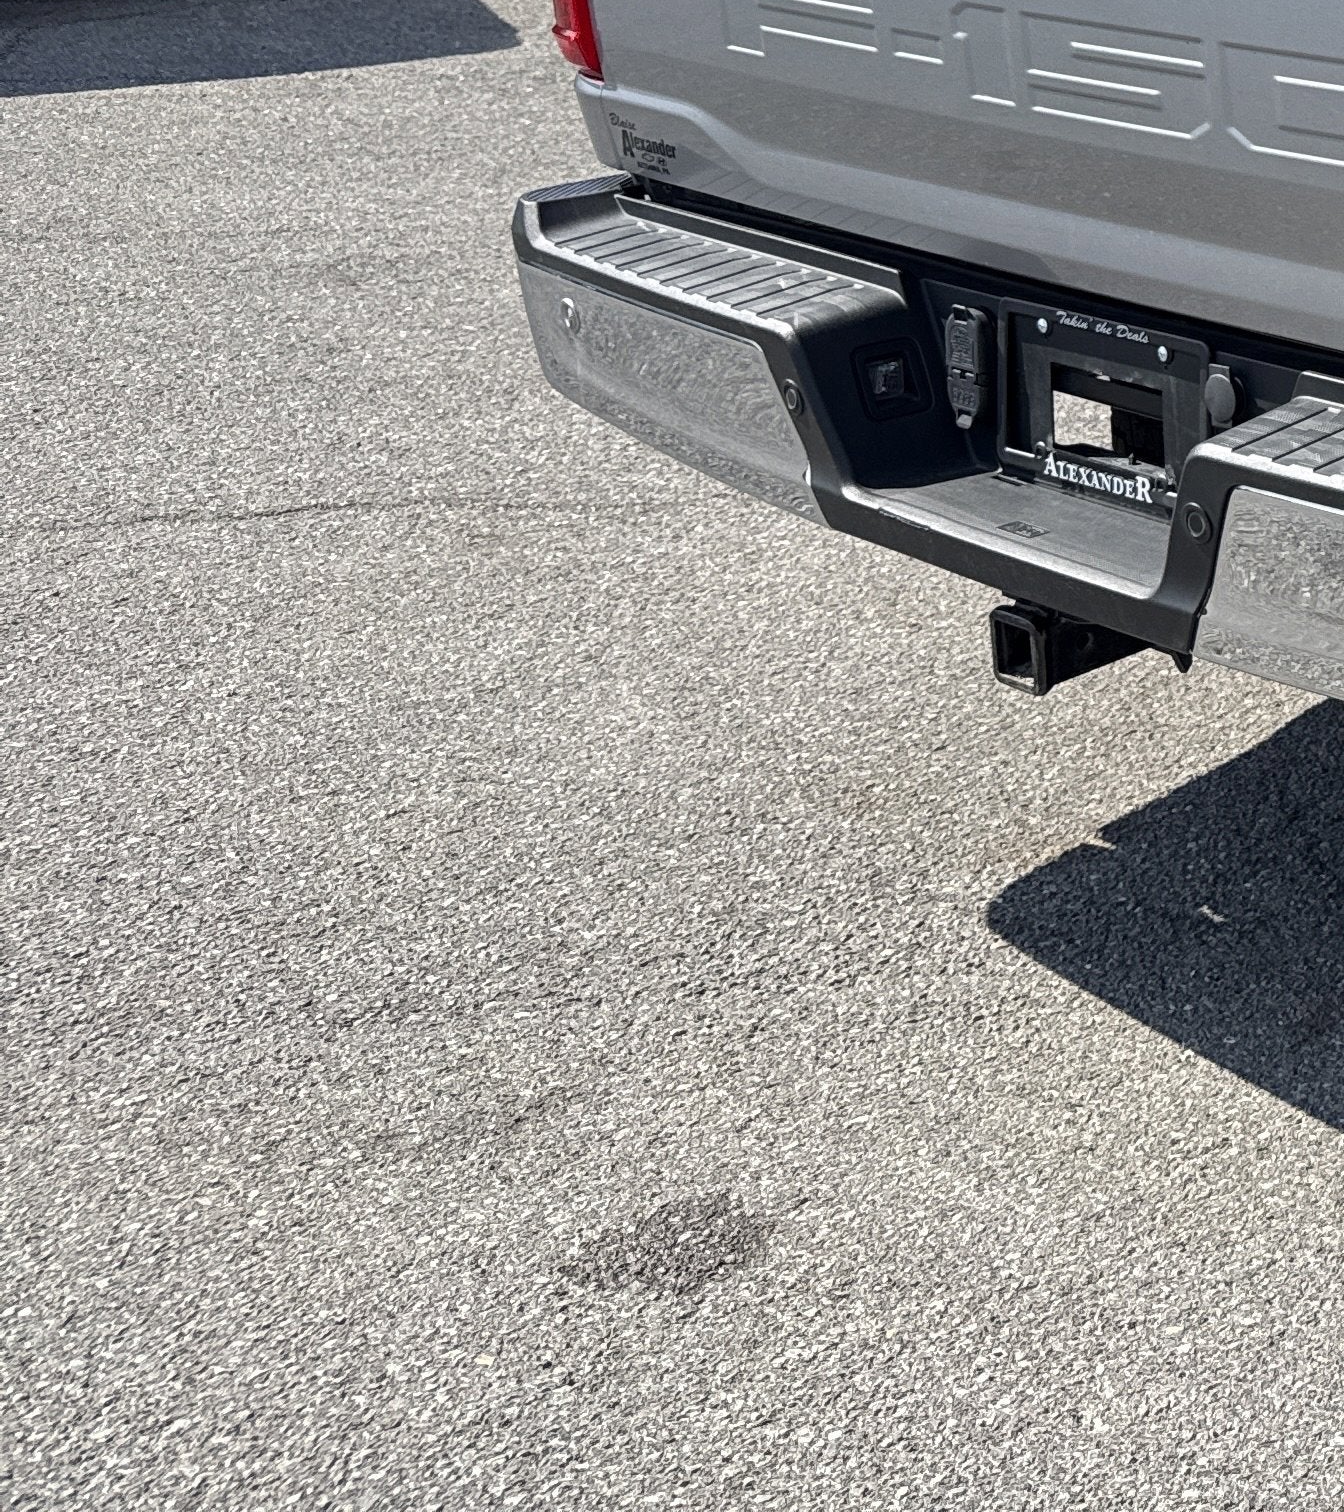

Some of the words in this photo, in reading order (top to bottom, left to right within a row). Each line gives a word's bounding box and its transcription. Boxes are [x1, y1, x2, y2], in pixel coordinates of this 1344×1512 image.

[621, 129, 677, 159] Alexander
[1095, 322, 1113, 335] the
[1116, 324, 1150, 344] Deals
[1044, 451, 1153, 504] ALEXANDER
